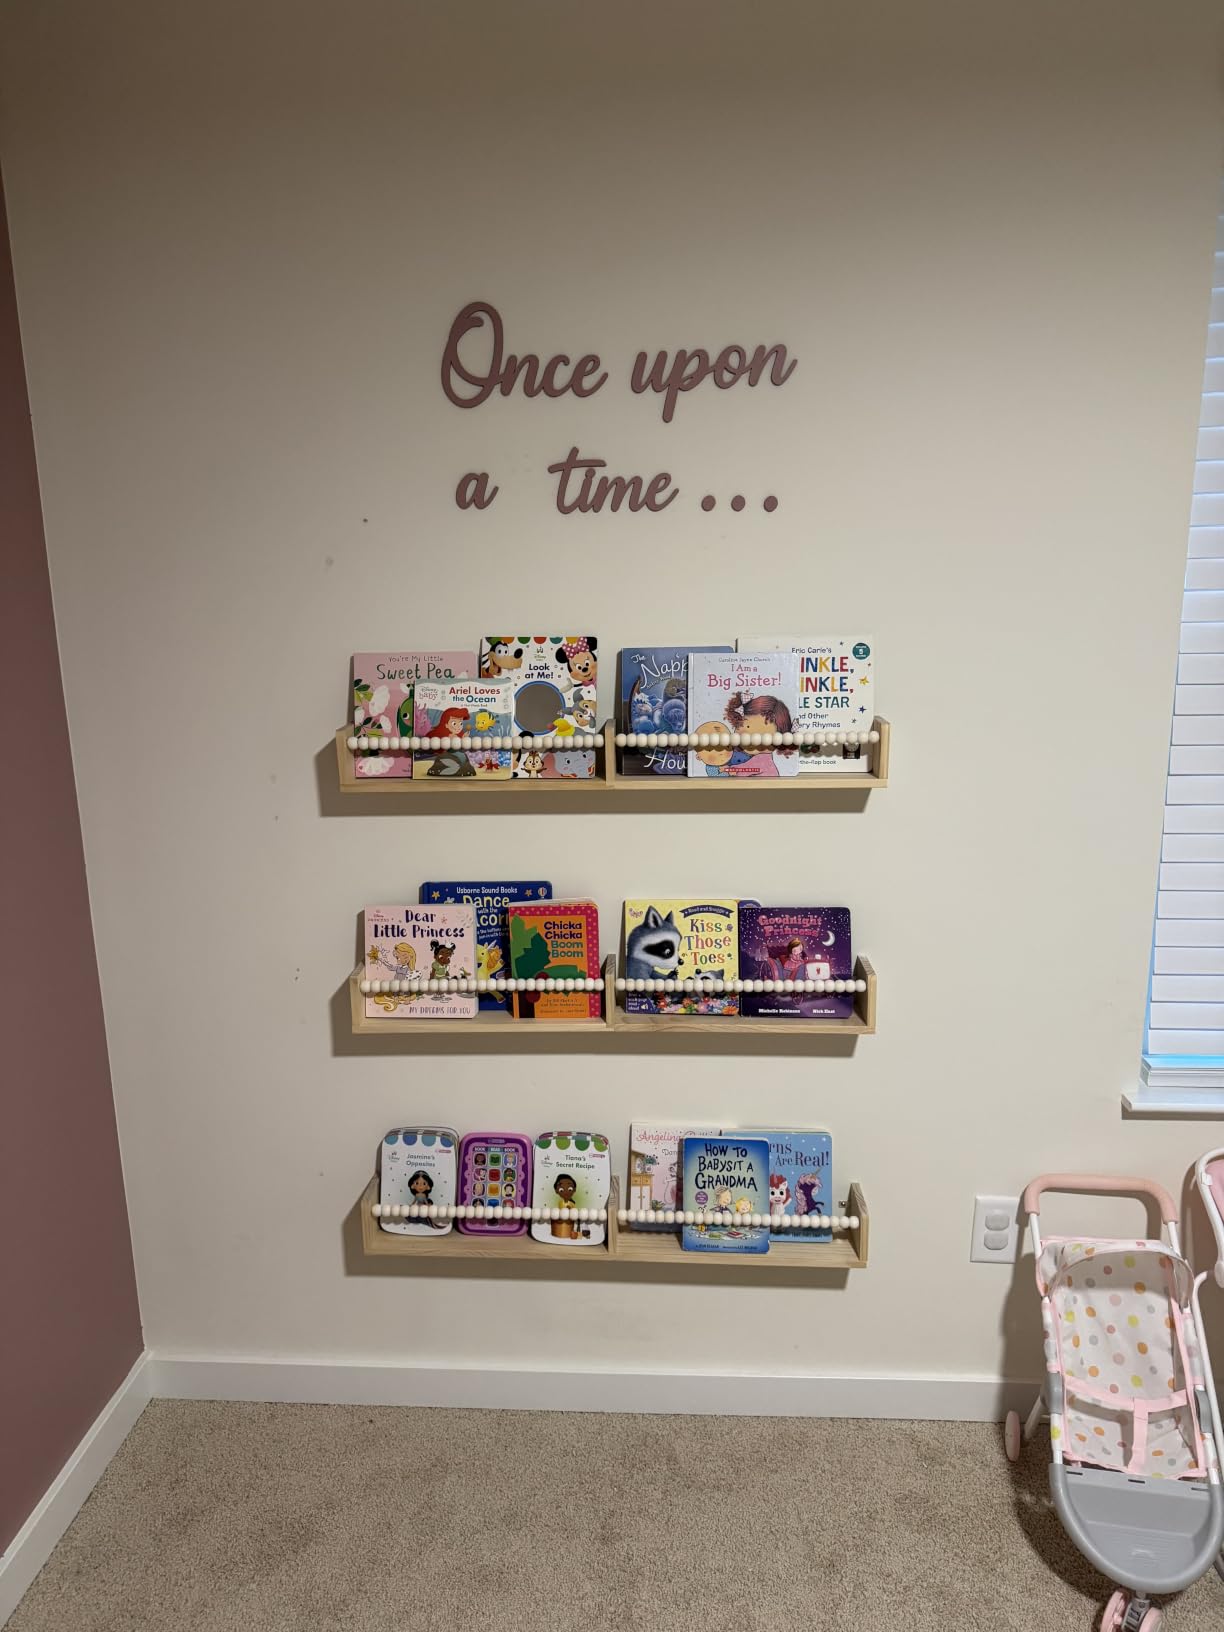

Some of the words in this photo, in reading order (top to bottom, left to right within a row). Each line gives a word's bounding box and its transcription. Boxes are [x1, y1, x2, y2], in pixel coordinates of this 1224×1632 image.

[441, 301, 608, 409] Once
[630, 343, 798, 423] upon
[455, 472, 499, 510] a
[547, 446, 680, 515] time
[376, 663, 421, 680] Sweet
[427, 663, 455, 679] Pea
[528, 663, 550, 671] Look
[736, 664, 752, 672] Am
[800, 656, 854, 674] INKLE,
[537, 671, 553, 679] Me!
[640, 655, 688, 689] Napp
[707, 673, 731, 690] Big
[735, 671, 782, 687] Sister!
[800, 676, 854, 694] INKLE,
[466, 695, 496, 703] Ocean
[798, 697, 810, 709] LE
[814, 696, 850, 709] STAR
[807, 712, 829, 720] Other
[812, 721, 841, 729] Rhymes
[643, 747, 687, 769] Hou
[462, 895, 510, 908] Dance
[405, 909, 436, 923] Dear
[476, 913, 509, 927] cor
[758, 914, 822, 926] Goodnight
[374, 924, 408, 938] Little
[412, 924, 465, 938] Princess
[544, 921, 582, 930] Chicka
[690, 919, 723, 933] Kiss
[763, 926, 819, 937] Princess
[544, 931, 582, 939] Chicka
[551, 940, 583, 948] Boom
[684, 934, 731, 951] Those
[551, 949, 583, 958] Boom
[691, 952, 725, 965] Toes
[704, 1143, 728, 1157] HOW
[769, 1143, 792, 1153] rns
[775, 1156, 796, 1166] Are
[795, 1151, 830, 1167] Real!
[747, 1162, 754, 1173] A
[695, 1172, 758, 1192] GRANDMA
